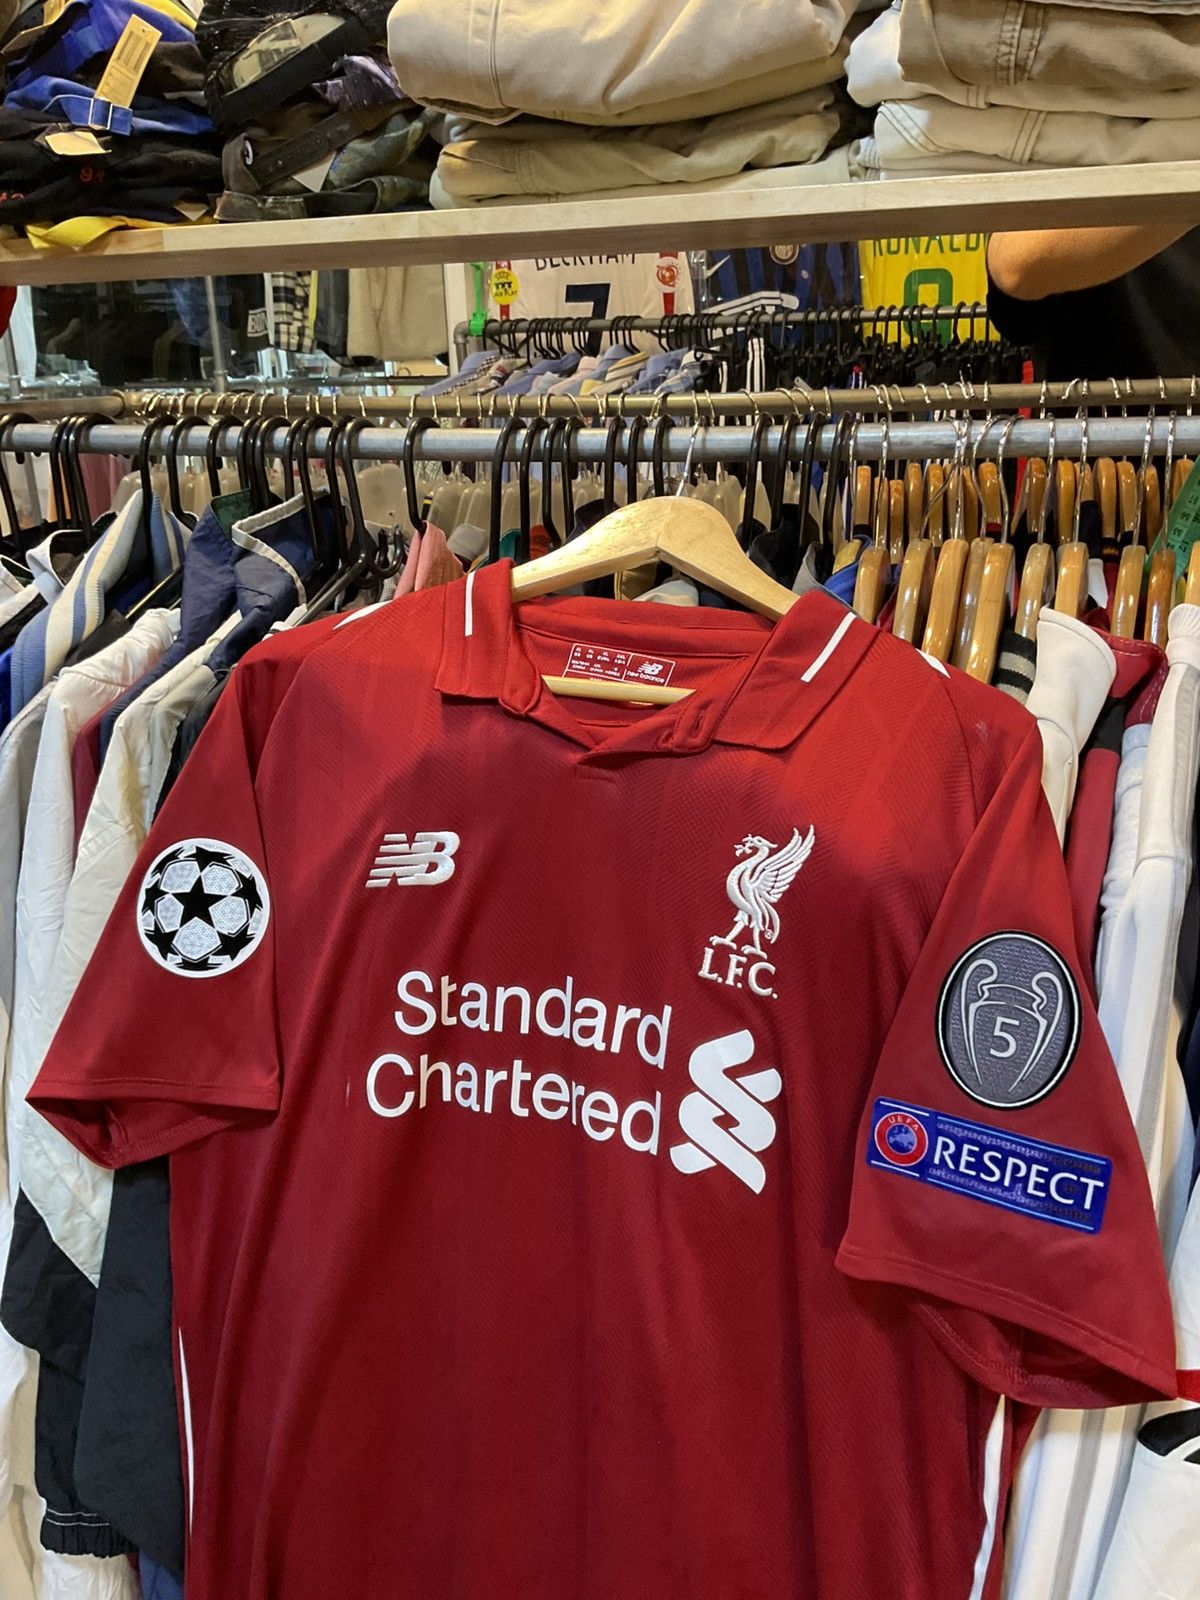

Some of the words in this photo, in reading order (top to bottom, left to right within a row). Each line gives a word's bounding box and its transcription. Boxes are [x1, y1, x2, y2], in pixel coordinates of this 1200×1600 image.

[565, 282, 611, 357] 7
[626, 670, 639, 678] new
[639, 673, 665, 684] balance
[394, 970, 673, 1070] Standard
[989, 1015, 1020, 1058] 5
[366, 1053, 662, 1156] Chartered
[887, 1114, 920, 1132] UEFA
[932, 1135, 1105, 1210] RESPECT
